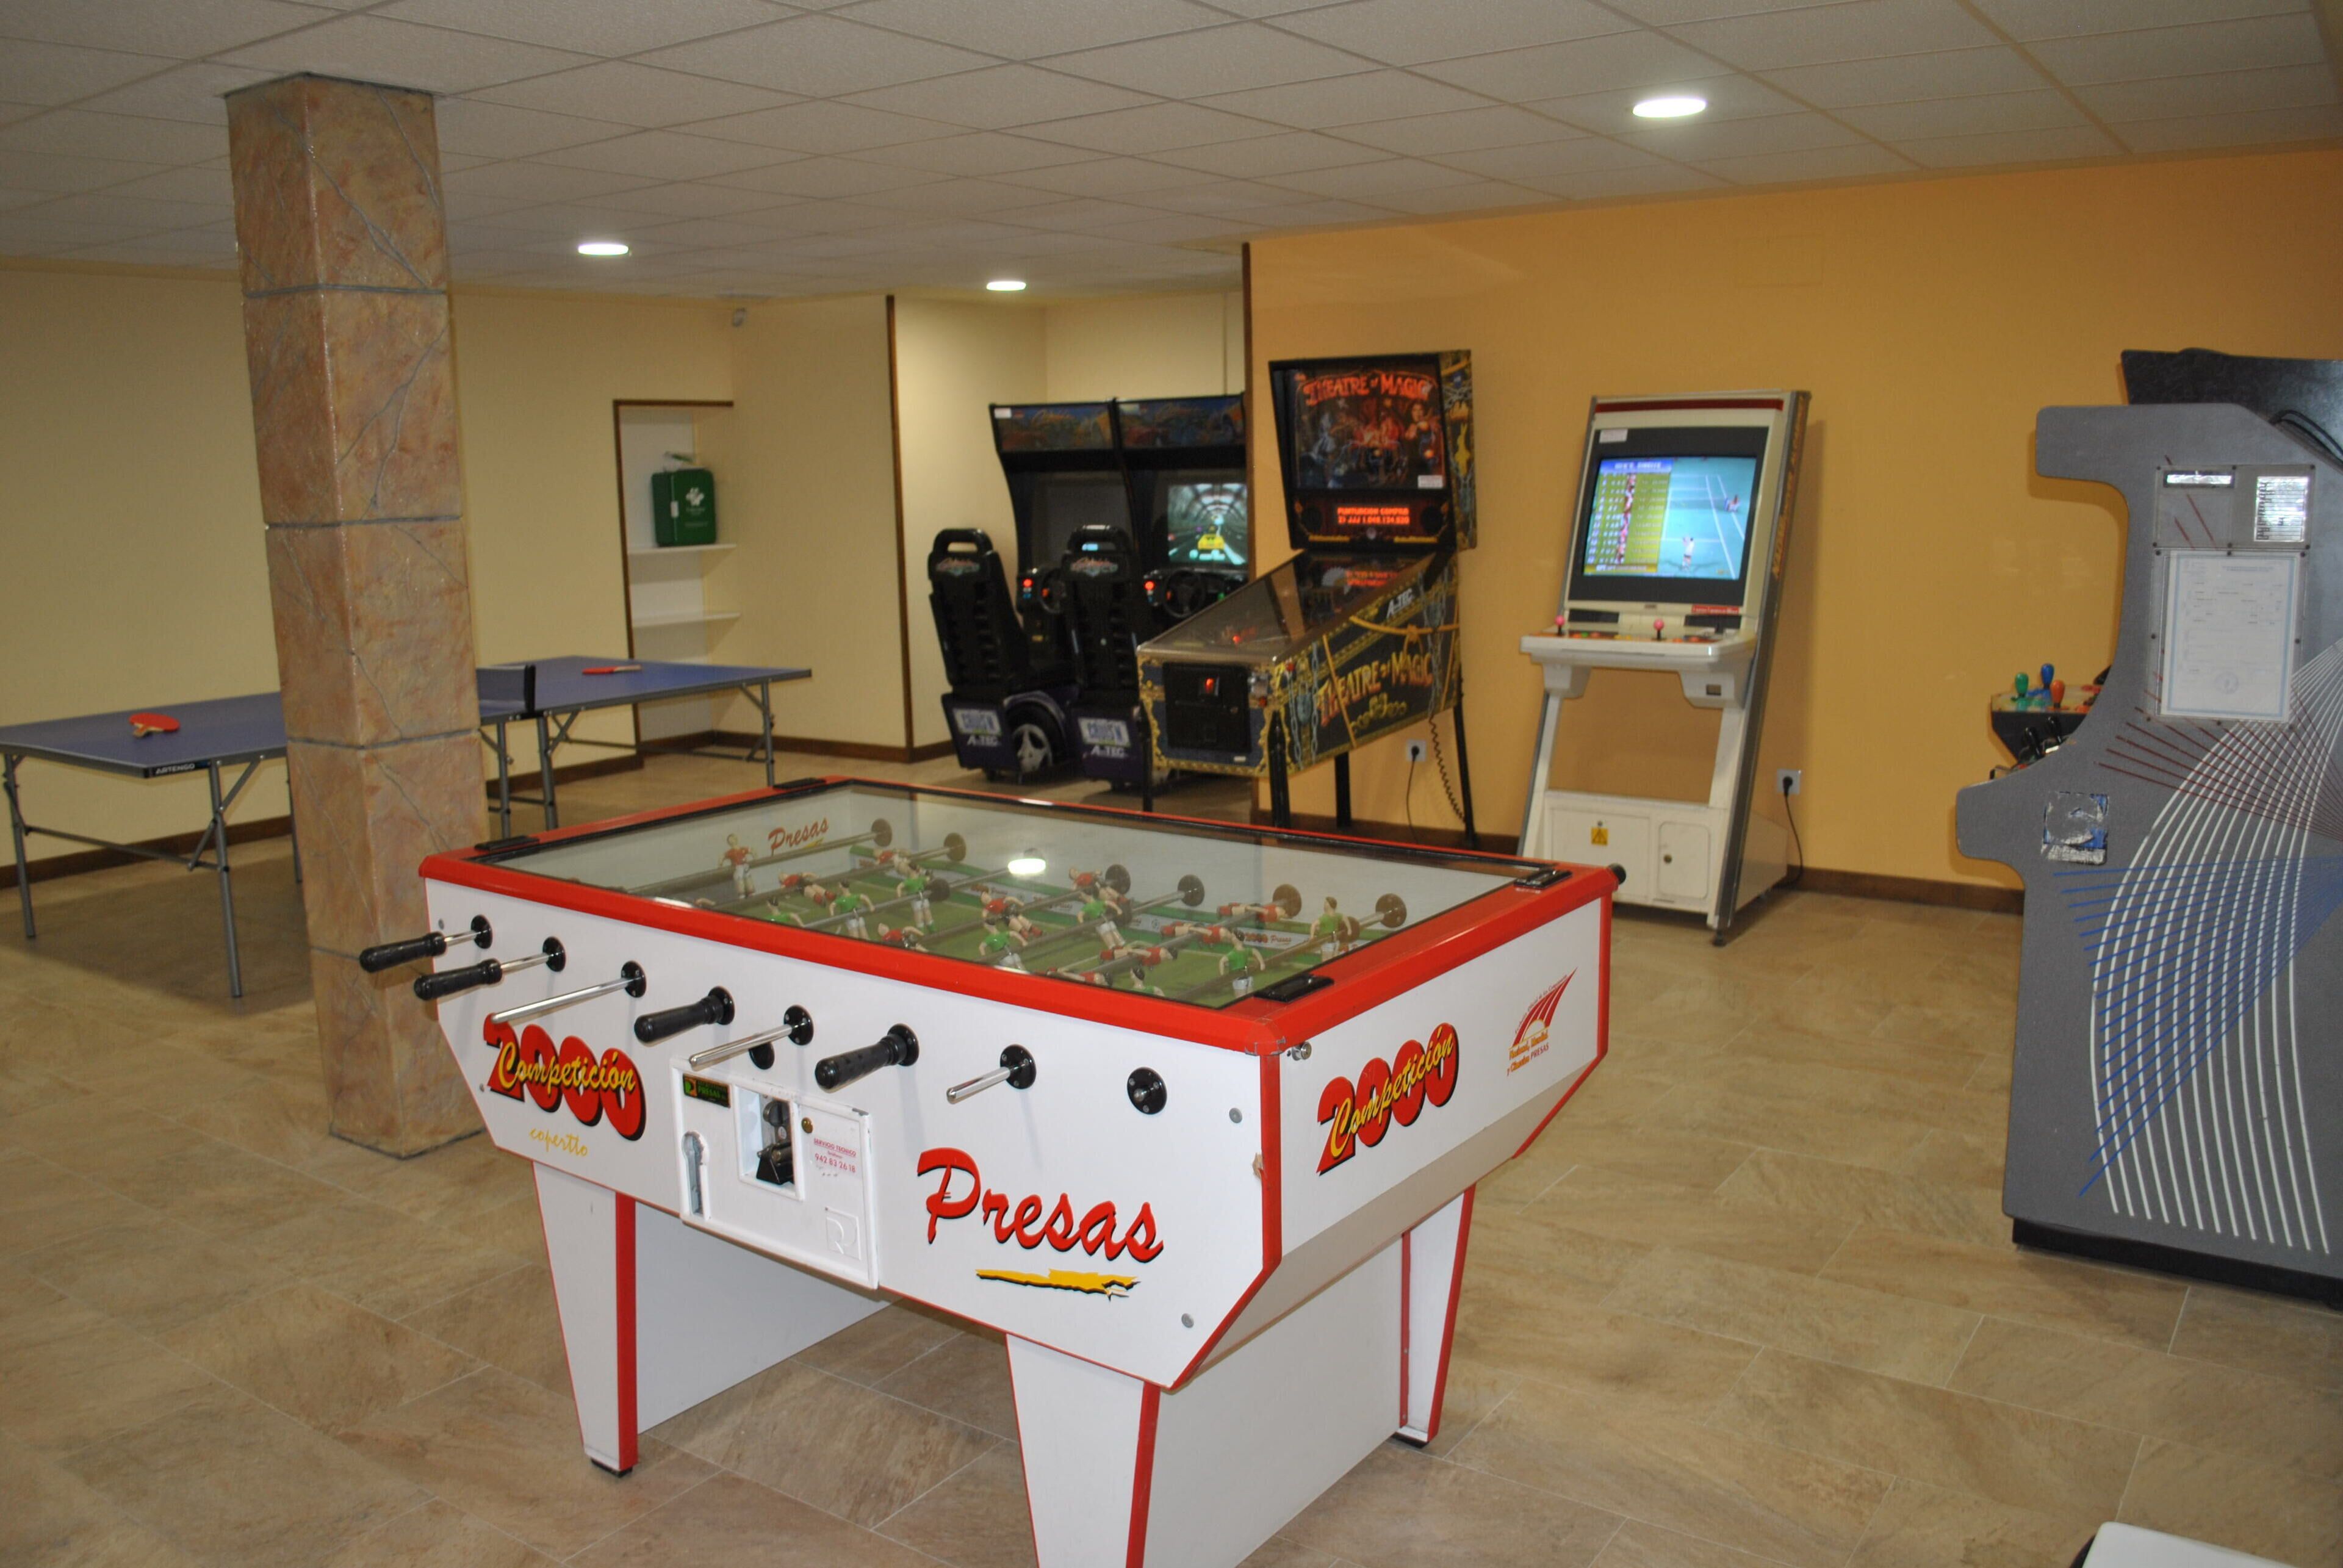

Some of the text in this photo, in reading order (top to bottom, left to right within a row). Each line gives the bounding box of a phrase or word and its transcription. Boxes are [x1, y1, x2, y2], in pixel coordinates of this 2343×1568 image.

[1303, 376, 1369, 406] THEATRE
[1381, 373, 1431, 400] MAGIC
[1317, 660, 1381, 727] THEATRE
[1391, 651, 1433, 687] MAGIC
[156, 763, 195, 774] ARTENGO
[768, 818, 829, 857] Presas
[498, 1041, 636, 1099] Competición
[1530, 1042, 1549, 1059] PRESAS
[1330, 1026, 1454, 1157] Competición
[815, 1153, 827, 1163] 942
[839, 1161, 848, 1170] 26
[849, 1163, 856, 1173] 18
[917, 1147, 1164, 1263] Presas
